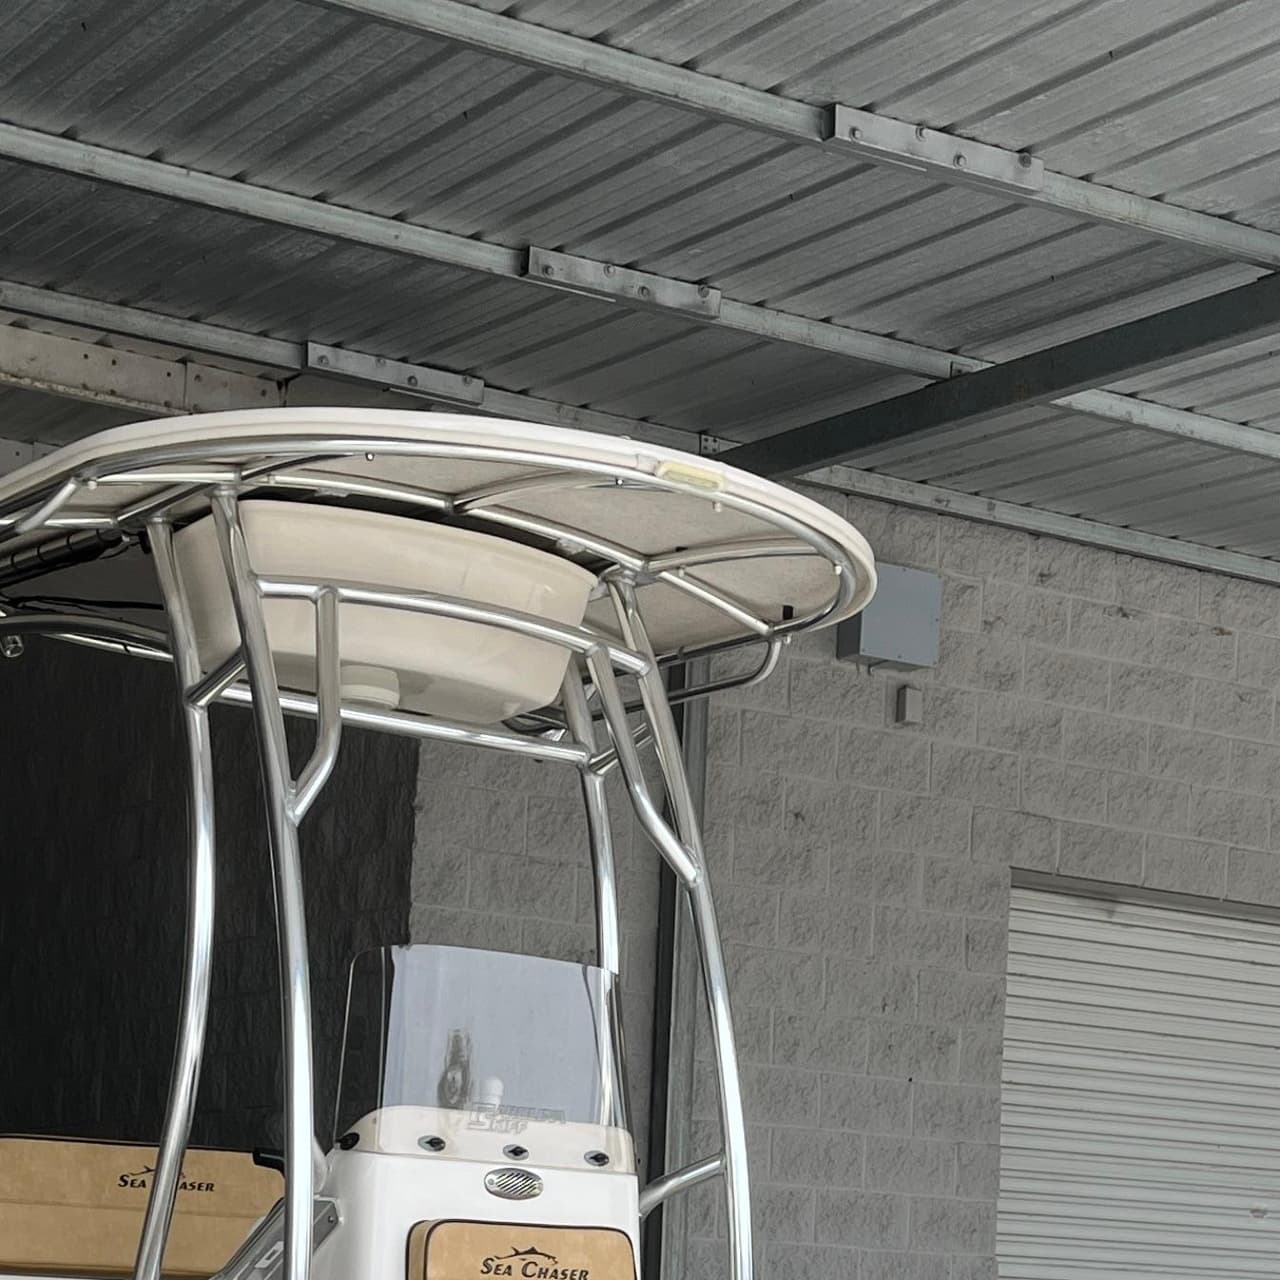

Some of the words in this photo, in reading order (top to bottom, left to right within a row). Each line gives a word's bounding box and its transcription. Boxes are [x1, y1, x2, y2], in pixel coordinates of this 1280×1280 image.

[118, 1173, 147, 1188] SEA
[178, 1181, 215, 1192] ASER
[480, 1257, 513, 1277] SEA
